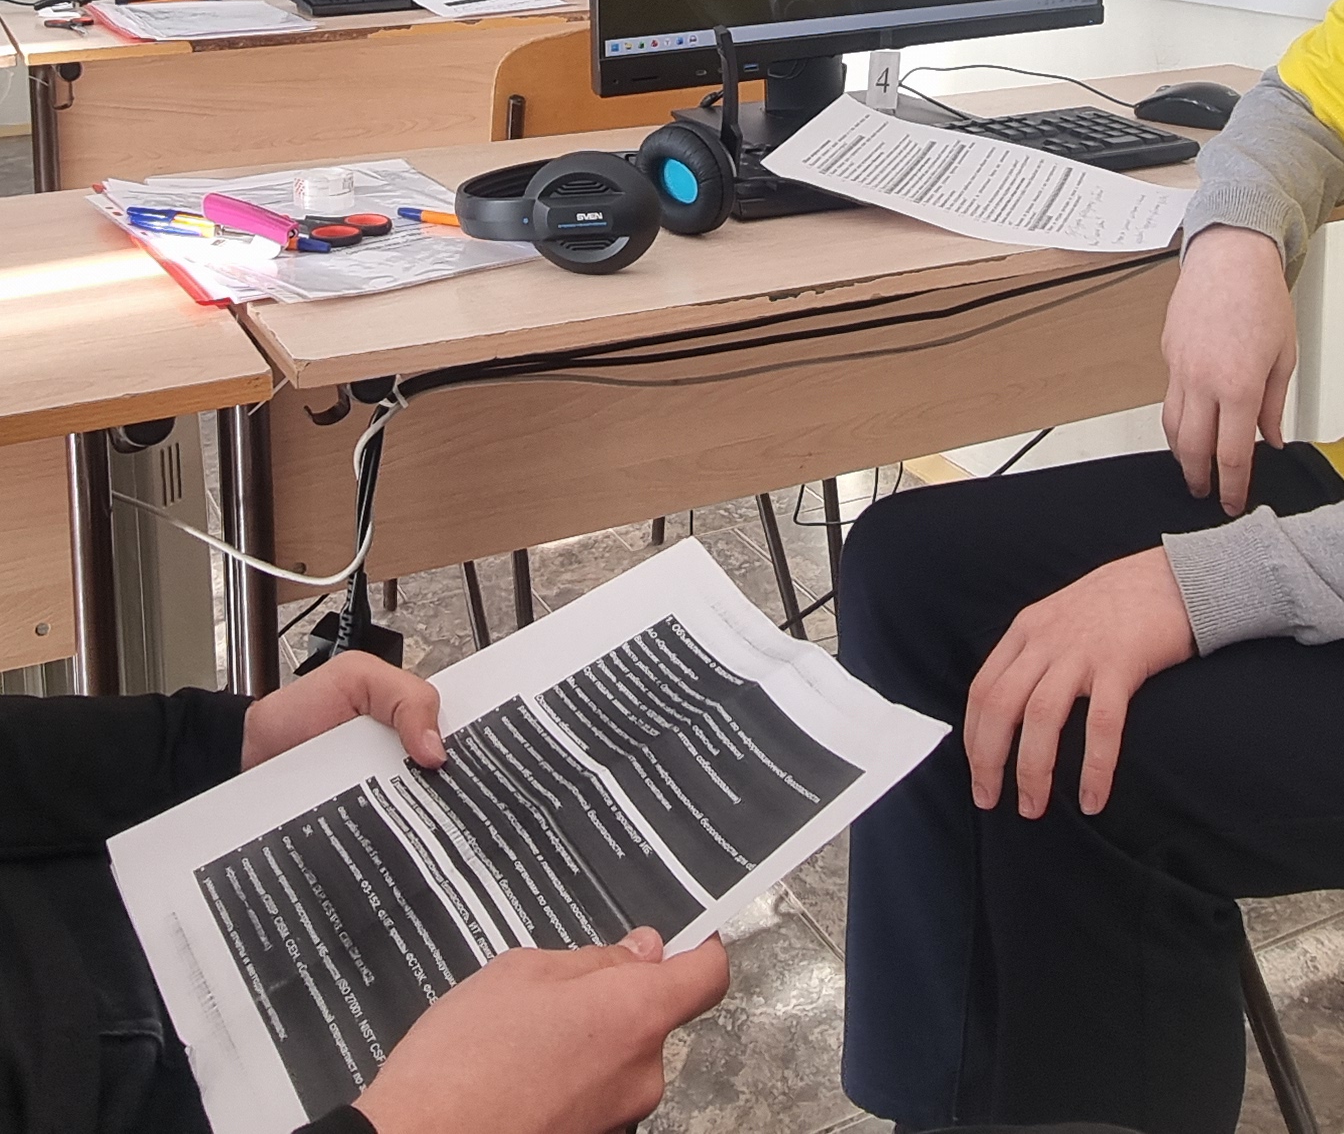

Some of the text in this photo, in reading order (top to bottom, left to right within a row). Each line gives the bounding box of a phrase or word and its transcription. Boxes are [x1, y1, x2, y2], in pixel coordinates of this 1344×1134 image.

[875, 67, 890, 93] 4
[576, 212, 603, 221] SVEN
[535, 894, 546, 906] по
[567, 941, 578, 953] И
